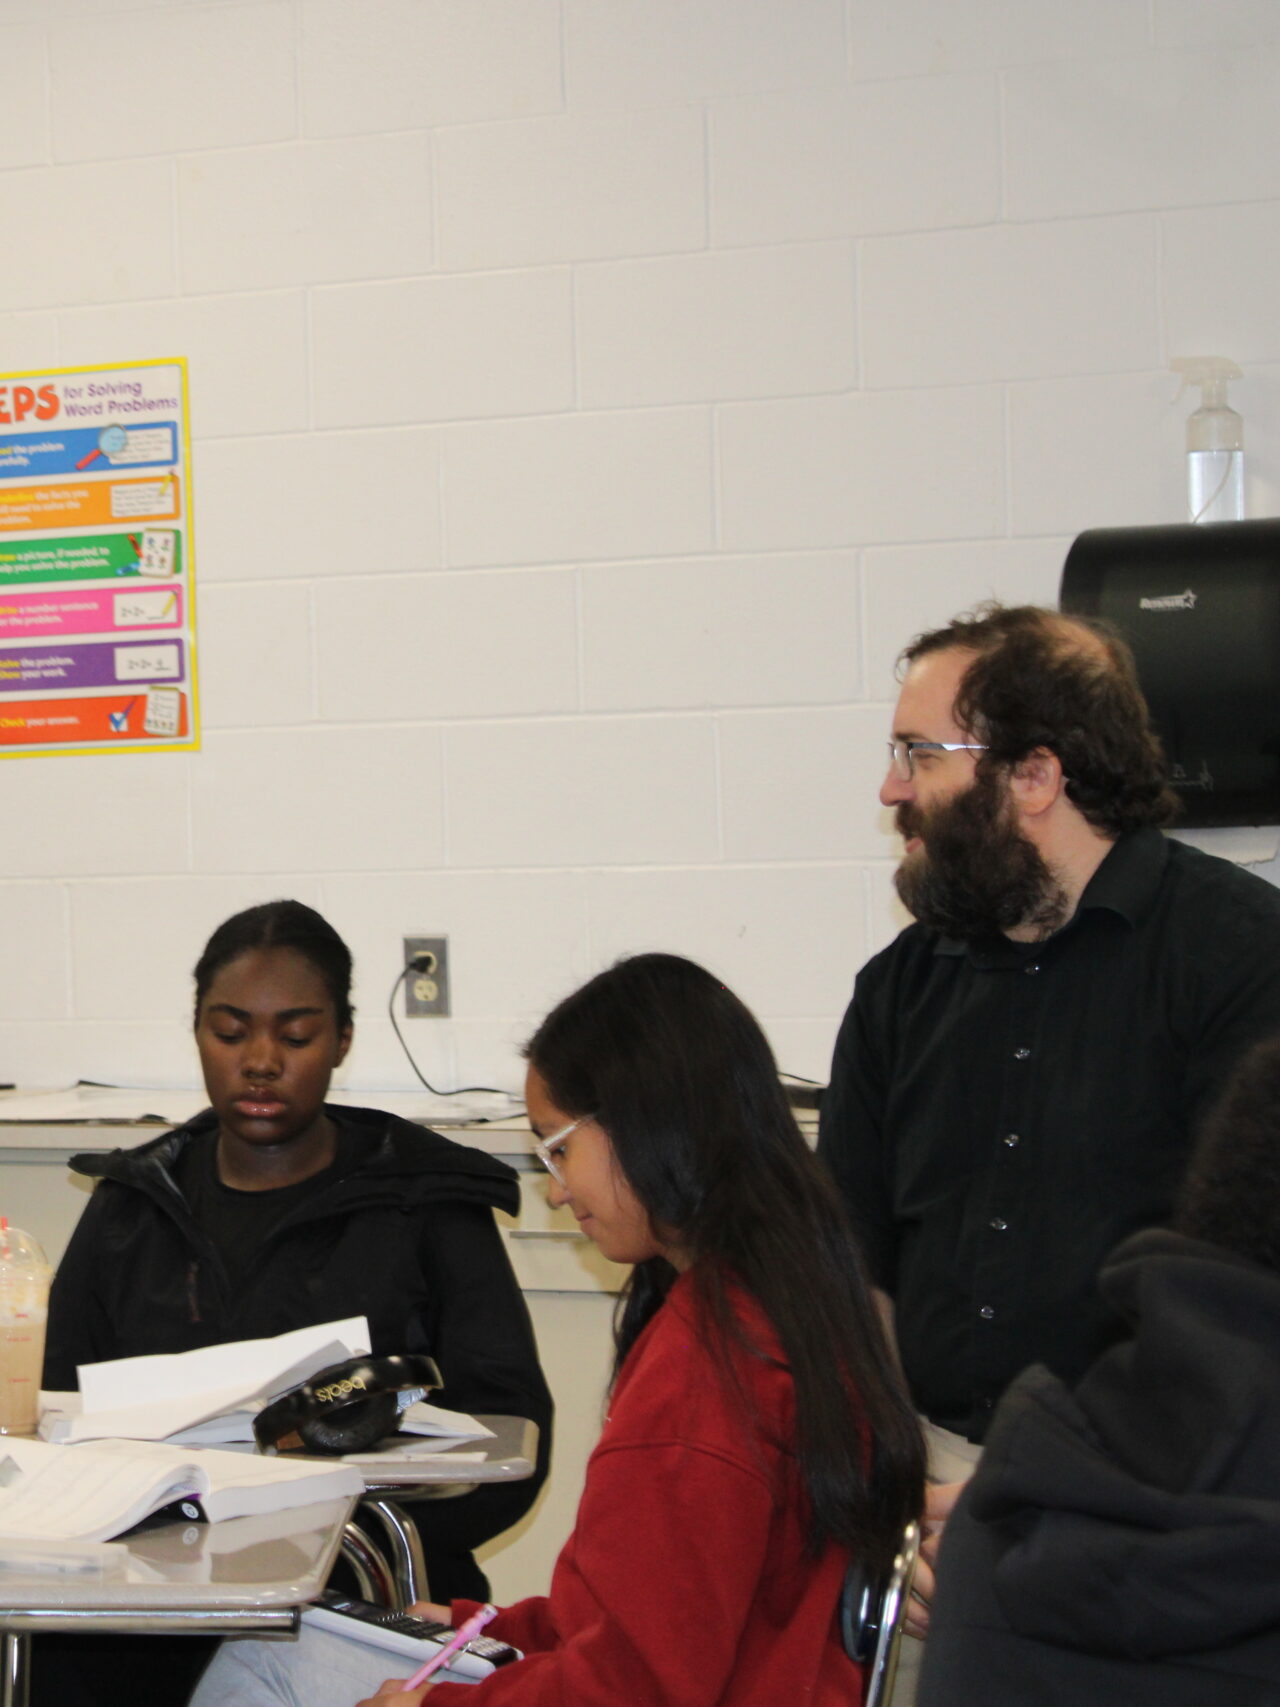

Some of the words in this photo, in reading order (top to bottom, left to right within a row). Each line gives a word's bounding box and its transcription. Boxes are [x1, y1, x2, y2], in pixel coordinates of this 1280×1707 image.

[63, 386, 83, 399] for
[87, 383, 142, 397] Solving
[64, 402, 103, 418] Word
[107, 398, 178, 414] Problems
[14, 445, 27, 454] the
[28, 442, 65, 455] problem
[35, 491, 50, 500] the
[32, 503, 42, 512] to
[66, 500, 81, 510] the
[64, 546, 99, 557] needed
[99, 546, 110, 556] to
[14, 563, 31, 574] you
[31, 561, 54, 571] solve
[55, 560, 69, 569] the
[70, 557, 111, 570] problem.
[25, 603, 59, 614] number
[60, 602, 99, 612] sentence
[9, 616, 23, 626] the
[23, 615, 63, 627] problem.
[21, 657, 36, 668] the
[36, 656, 76, 669] problem.
[22, 669, 41, 681] your
[42, 667, 67, 678] work.
[0, 717, 27, 728] Check
[27, 717, 46, 728] your
[315, 1375, 367, 1402] beats
